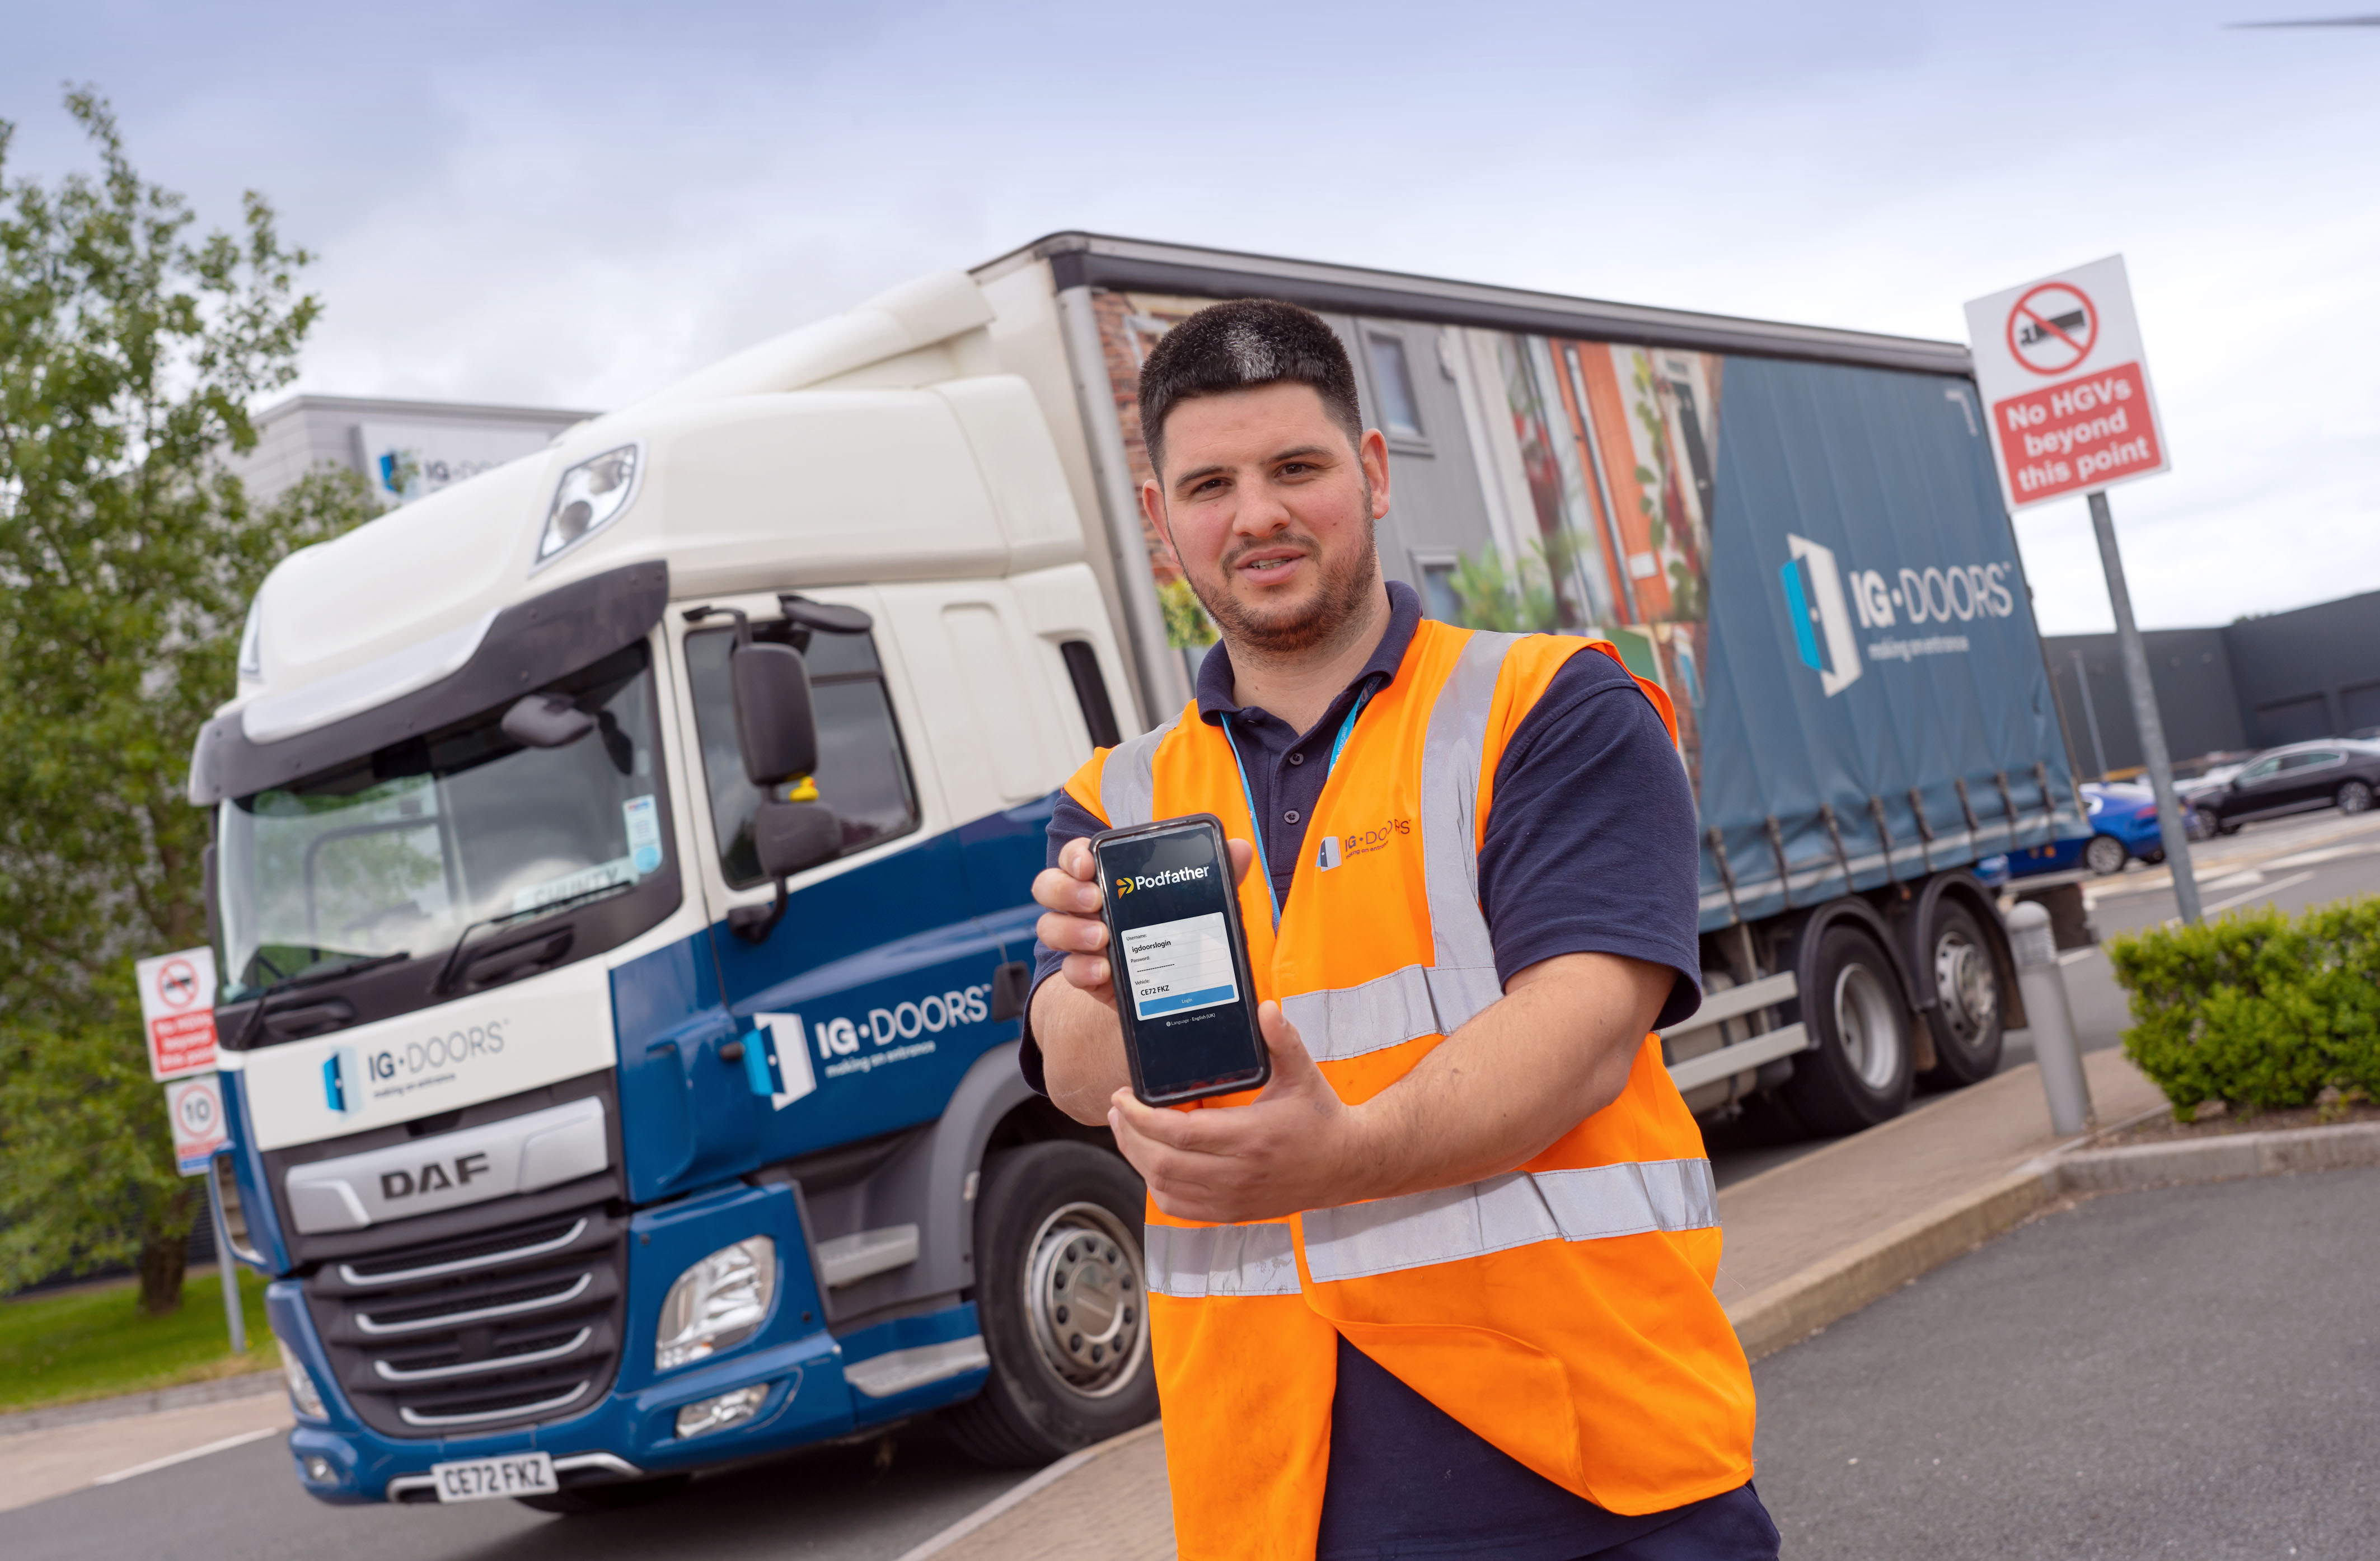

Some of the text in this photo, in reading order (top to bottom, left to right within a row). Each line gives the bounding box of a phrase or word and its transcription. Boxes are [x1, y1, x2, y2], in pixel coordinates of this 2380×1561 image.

[2005, 377, 2131, 431] No HGVs
[2023, 408, 2128, 457] beyond
[2018, 436, 2149, 492] this point
[1135, 866, 1209, 890] Podfather
[1132, 940, 1171, 953] igdoorslogin
[186, 1097, 210, 1123] 10
[381, 1151, 490, 1200] DAF
[444, 1460, 546, 1494] CE72 FKZ
